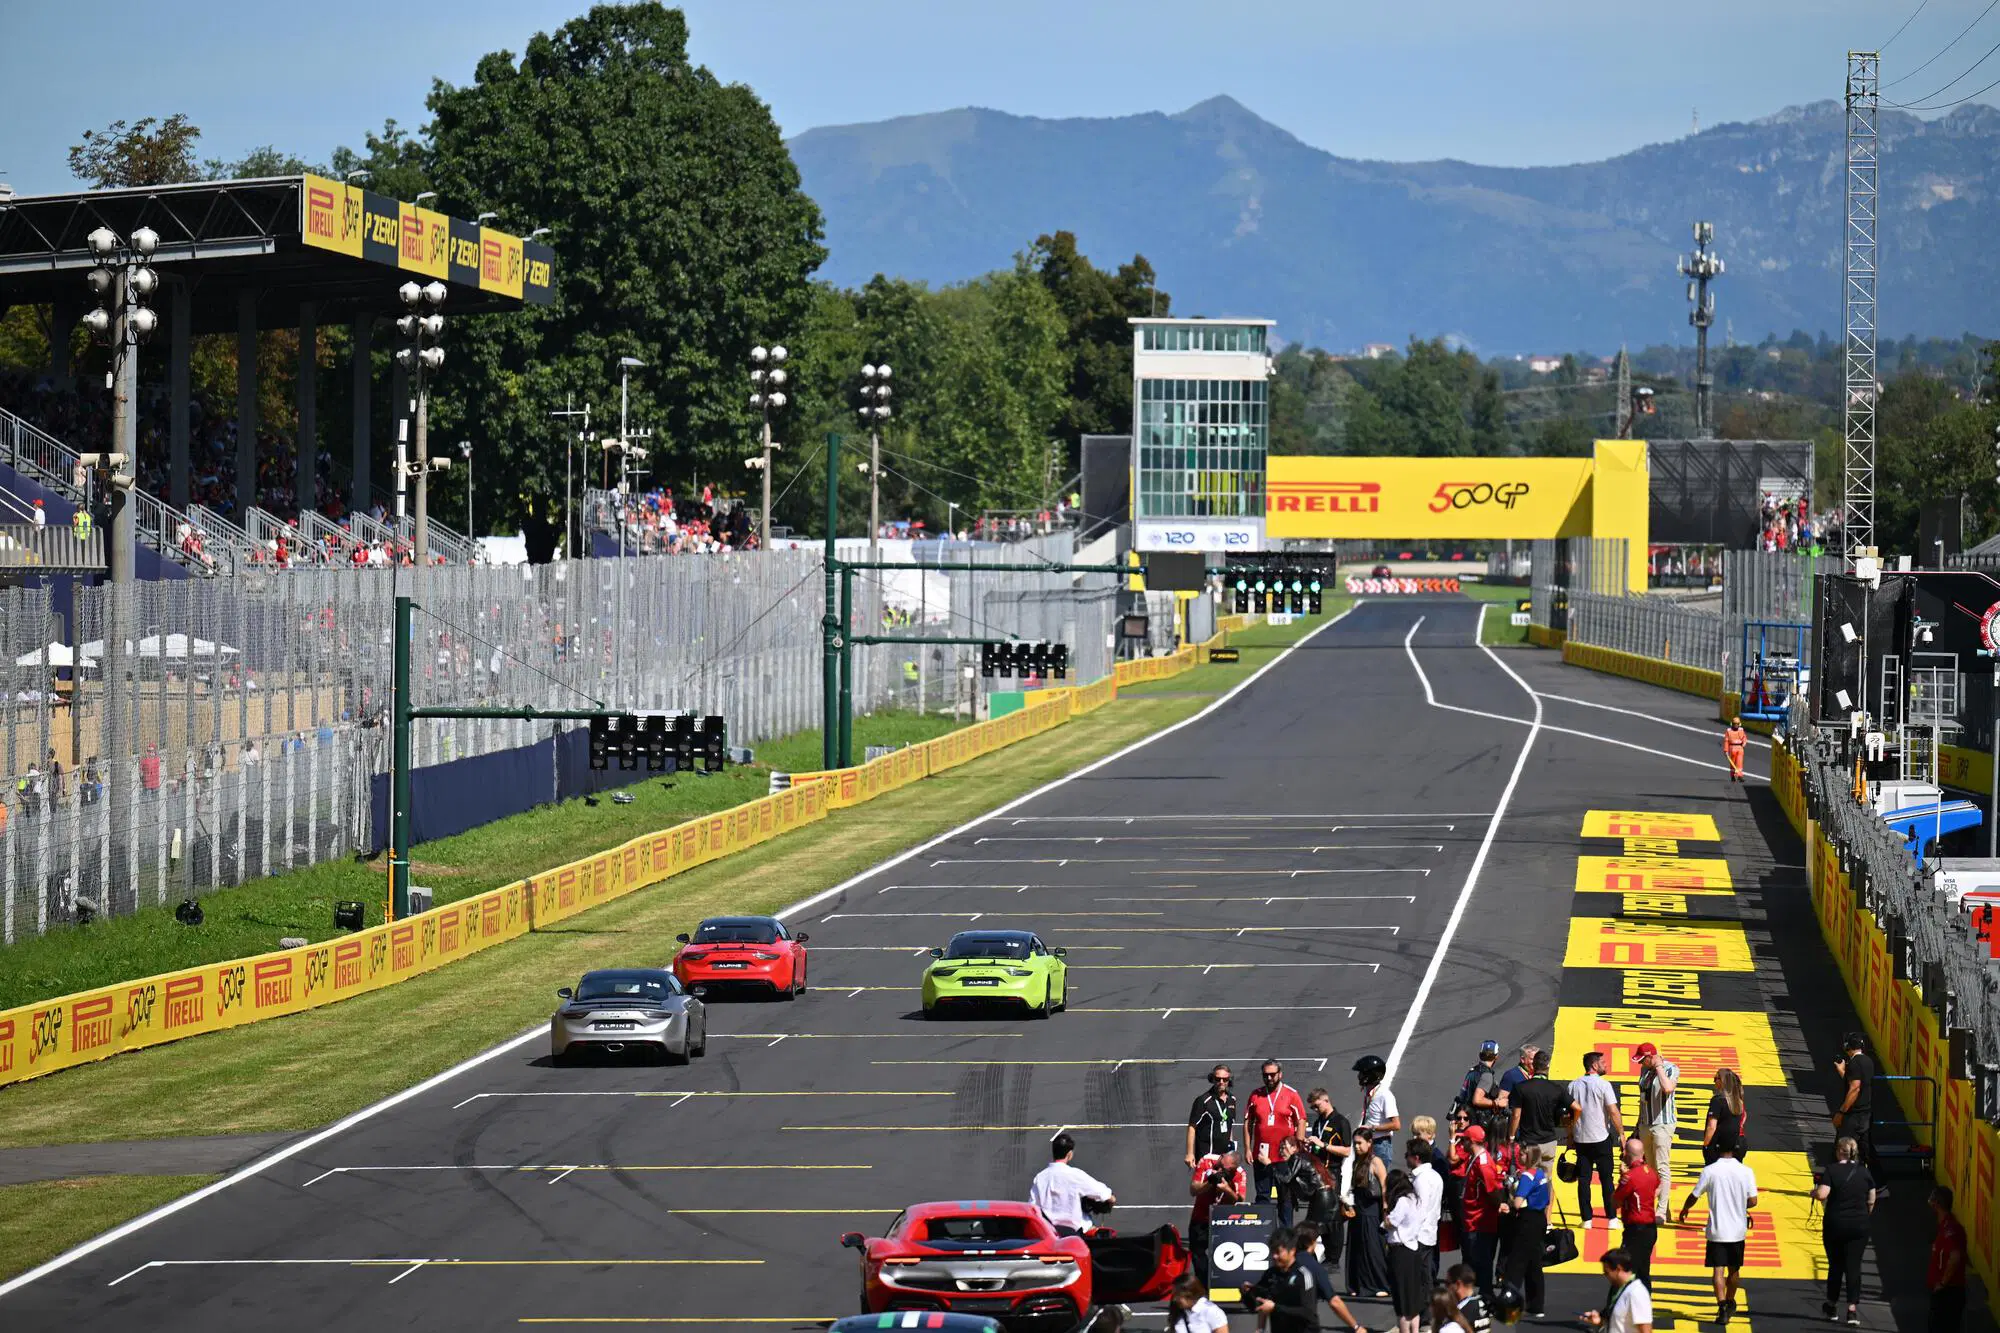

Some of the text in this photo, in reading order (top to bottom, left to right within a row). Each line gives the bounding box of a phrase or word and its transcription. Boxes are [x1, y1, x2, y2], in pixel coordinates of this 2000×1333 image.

[309, 187, 334, 238] PIRELLI
[364, 212, 398, 246] P ZERO
[402, 214, 424, 261] PIRELLI
[450, 237, 479, 269] P ZERO
[483, 239, 501, 281] PIRELLI
[523, 258, 549, 287] P ZERO
[1165, 532, 1195, 544] 120
[1224, 532, 1249, 544] 120
[392, 925, 414, 972] PIRELLI
[440, 911, 459, 955] PIRELLI
[254, 957, 292, 1008] PIRELLI
[334, 941, 362, 989] PIRELLI
[164, 975, 204, 1029] PIRELLI
[72, 996, 113, 1053] PIRELLI
[1213, 1241, 1270, 1272] 02
